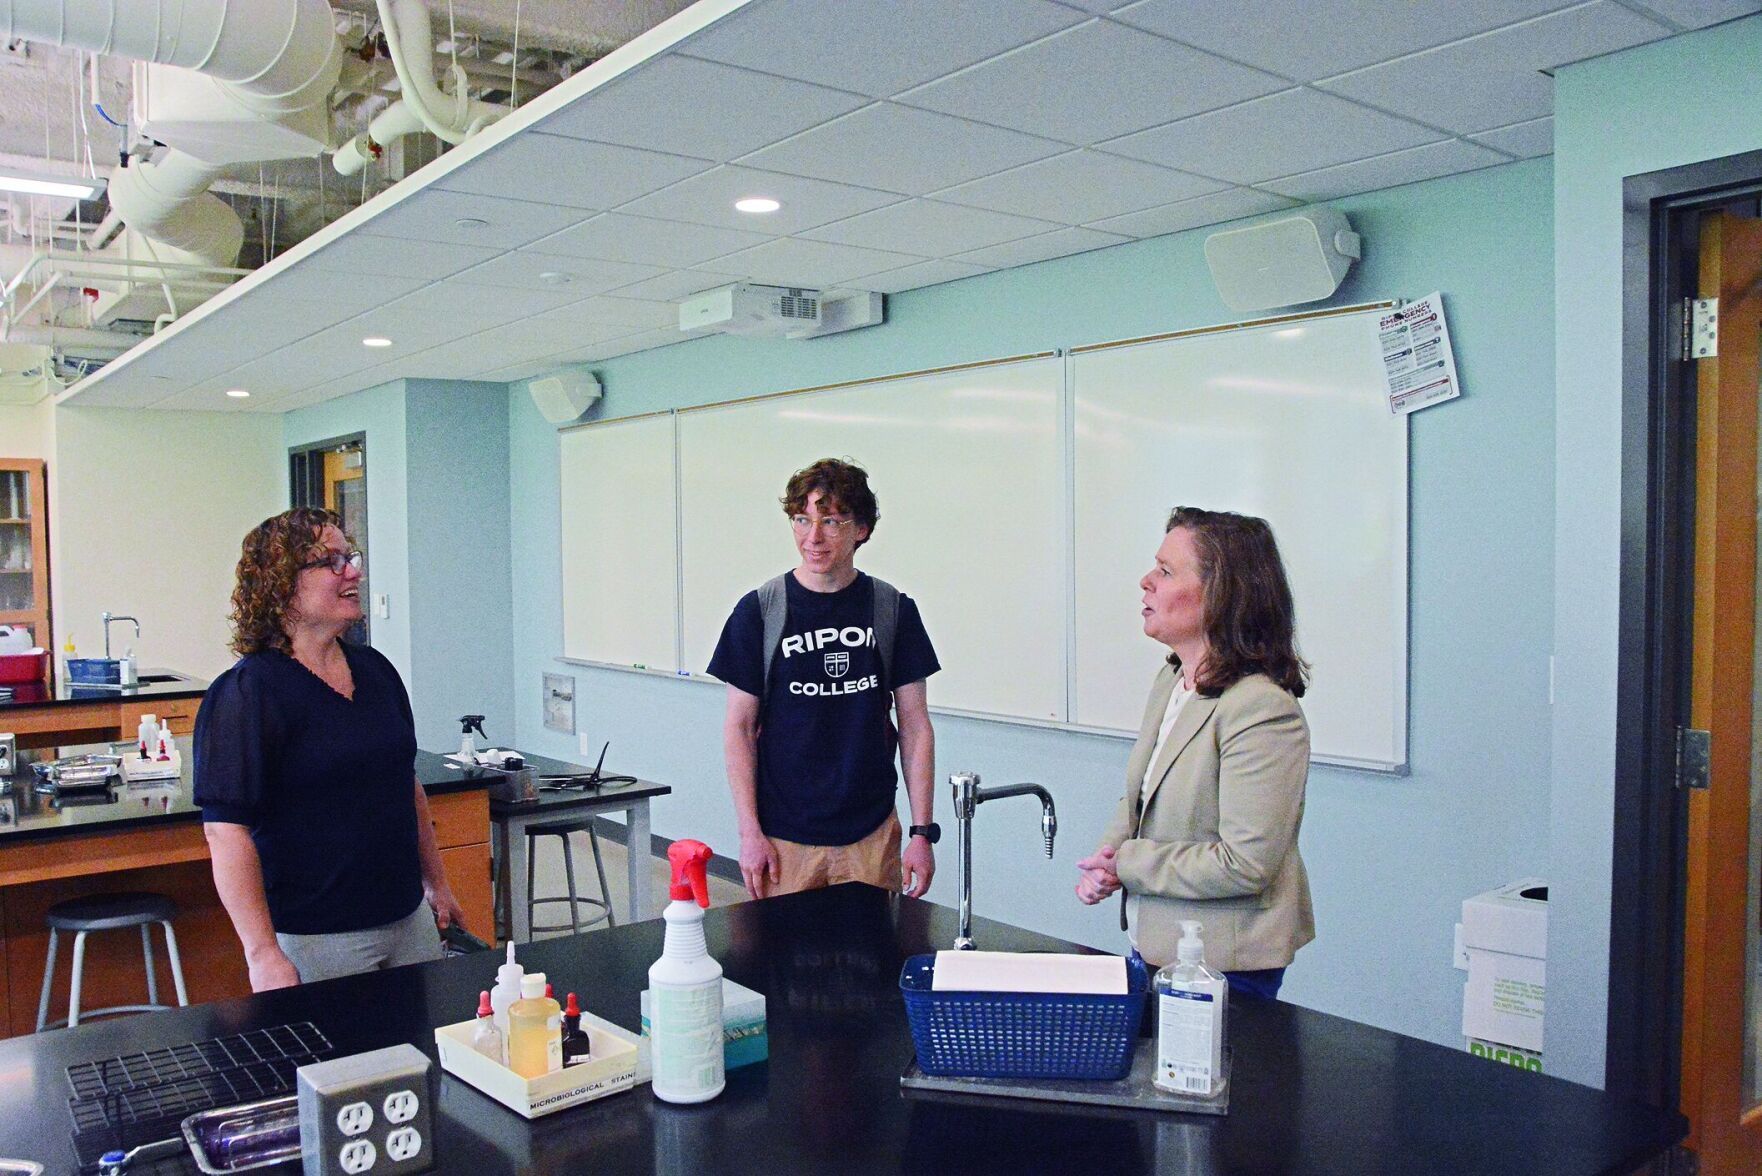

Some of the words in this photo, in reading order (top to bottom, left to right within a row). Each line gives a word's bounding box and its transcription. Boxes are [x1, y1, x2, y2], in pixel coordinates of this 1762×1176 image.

[1380, 304, 1430, 326] EMEGENCY
[789, 675, 878, 696] COLLEGE
[530, 1083, 604, 1110] MICROBIOLOGICAL
